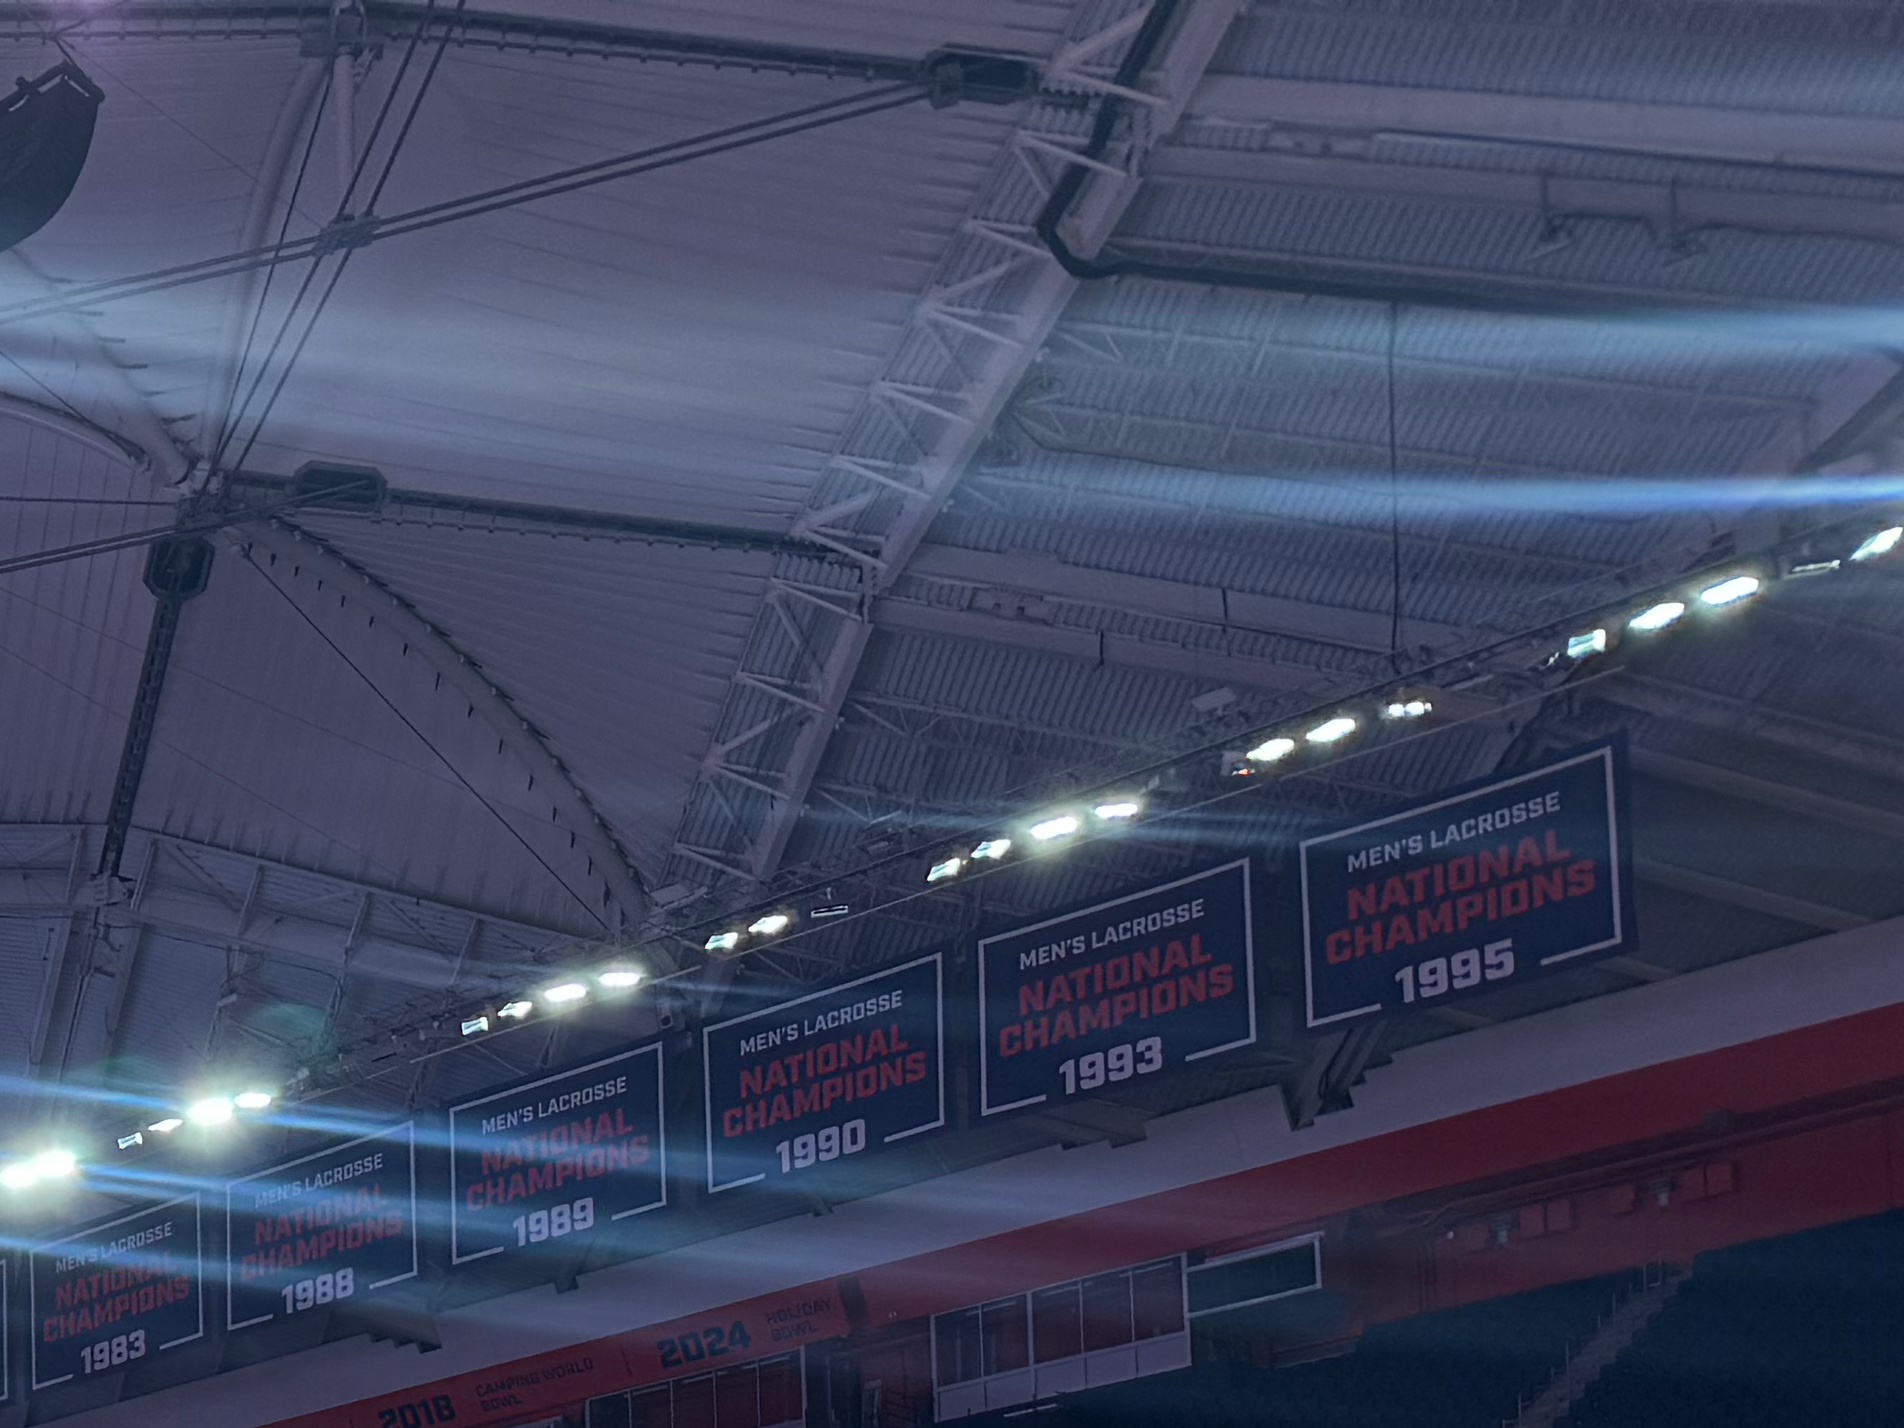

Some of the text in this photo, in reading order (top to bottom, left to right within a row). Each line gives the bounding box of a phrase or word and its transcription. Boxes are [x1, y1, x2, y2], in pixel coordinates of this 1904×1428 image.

[1348, 791, 1560, 872] MEN'S LACROSSE
[1348, 829, 1571, 921] NATIONAL
[1019, 898, 1205, 970] MEN'S LACROSSE
[1326, 859, 1597, 965] CHAMPIONS
[1018, 933, 1213, 1015] NATIONAL
[1395, 938, 1515, 1003] 1995
[740, 990, 903, 1056] MEN'S LACROSSE
[999, 963, 1234, 1058] CHAMPIONS
[722, 1050, 926, 1139] CHAMPIONS
[739, 1024, 909, 1099] NATIONAL
[1059, 1036, 1163, 1095] 1993
[482, 1076, 627, 1135] MEN'S LACROSSE
[466, 1134, 651, 1212] CHAMPIONS
[481, 1108, 633, 1175] NATIONAL
[775, 1118, 866, 1174] 1990
[255, 1153, 384, 1209] MEN'S LACROSSE
[56, 1221, 172, 1273] MEN'S LACROSSE
[240, 1209, 404, 1282] CHAMPIONS
[254, 1184, 382, 1246] NATIONAL
[513, 1197, 595, 1247] 1989
[43, 1275, 190, 1343] CHAMPIONS
[56, 1255, 178, 1308] NATIONAL
[282, 1267, 353, 1314] 1988
[80, 1329, 146, 1375] 1983
[657, 1298, 833, 1369] 2024 HOLIDAY
[476, 1370, 540, 1398] CAMPING
[542, 1357, 593, 1382] WORLD
